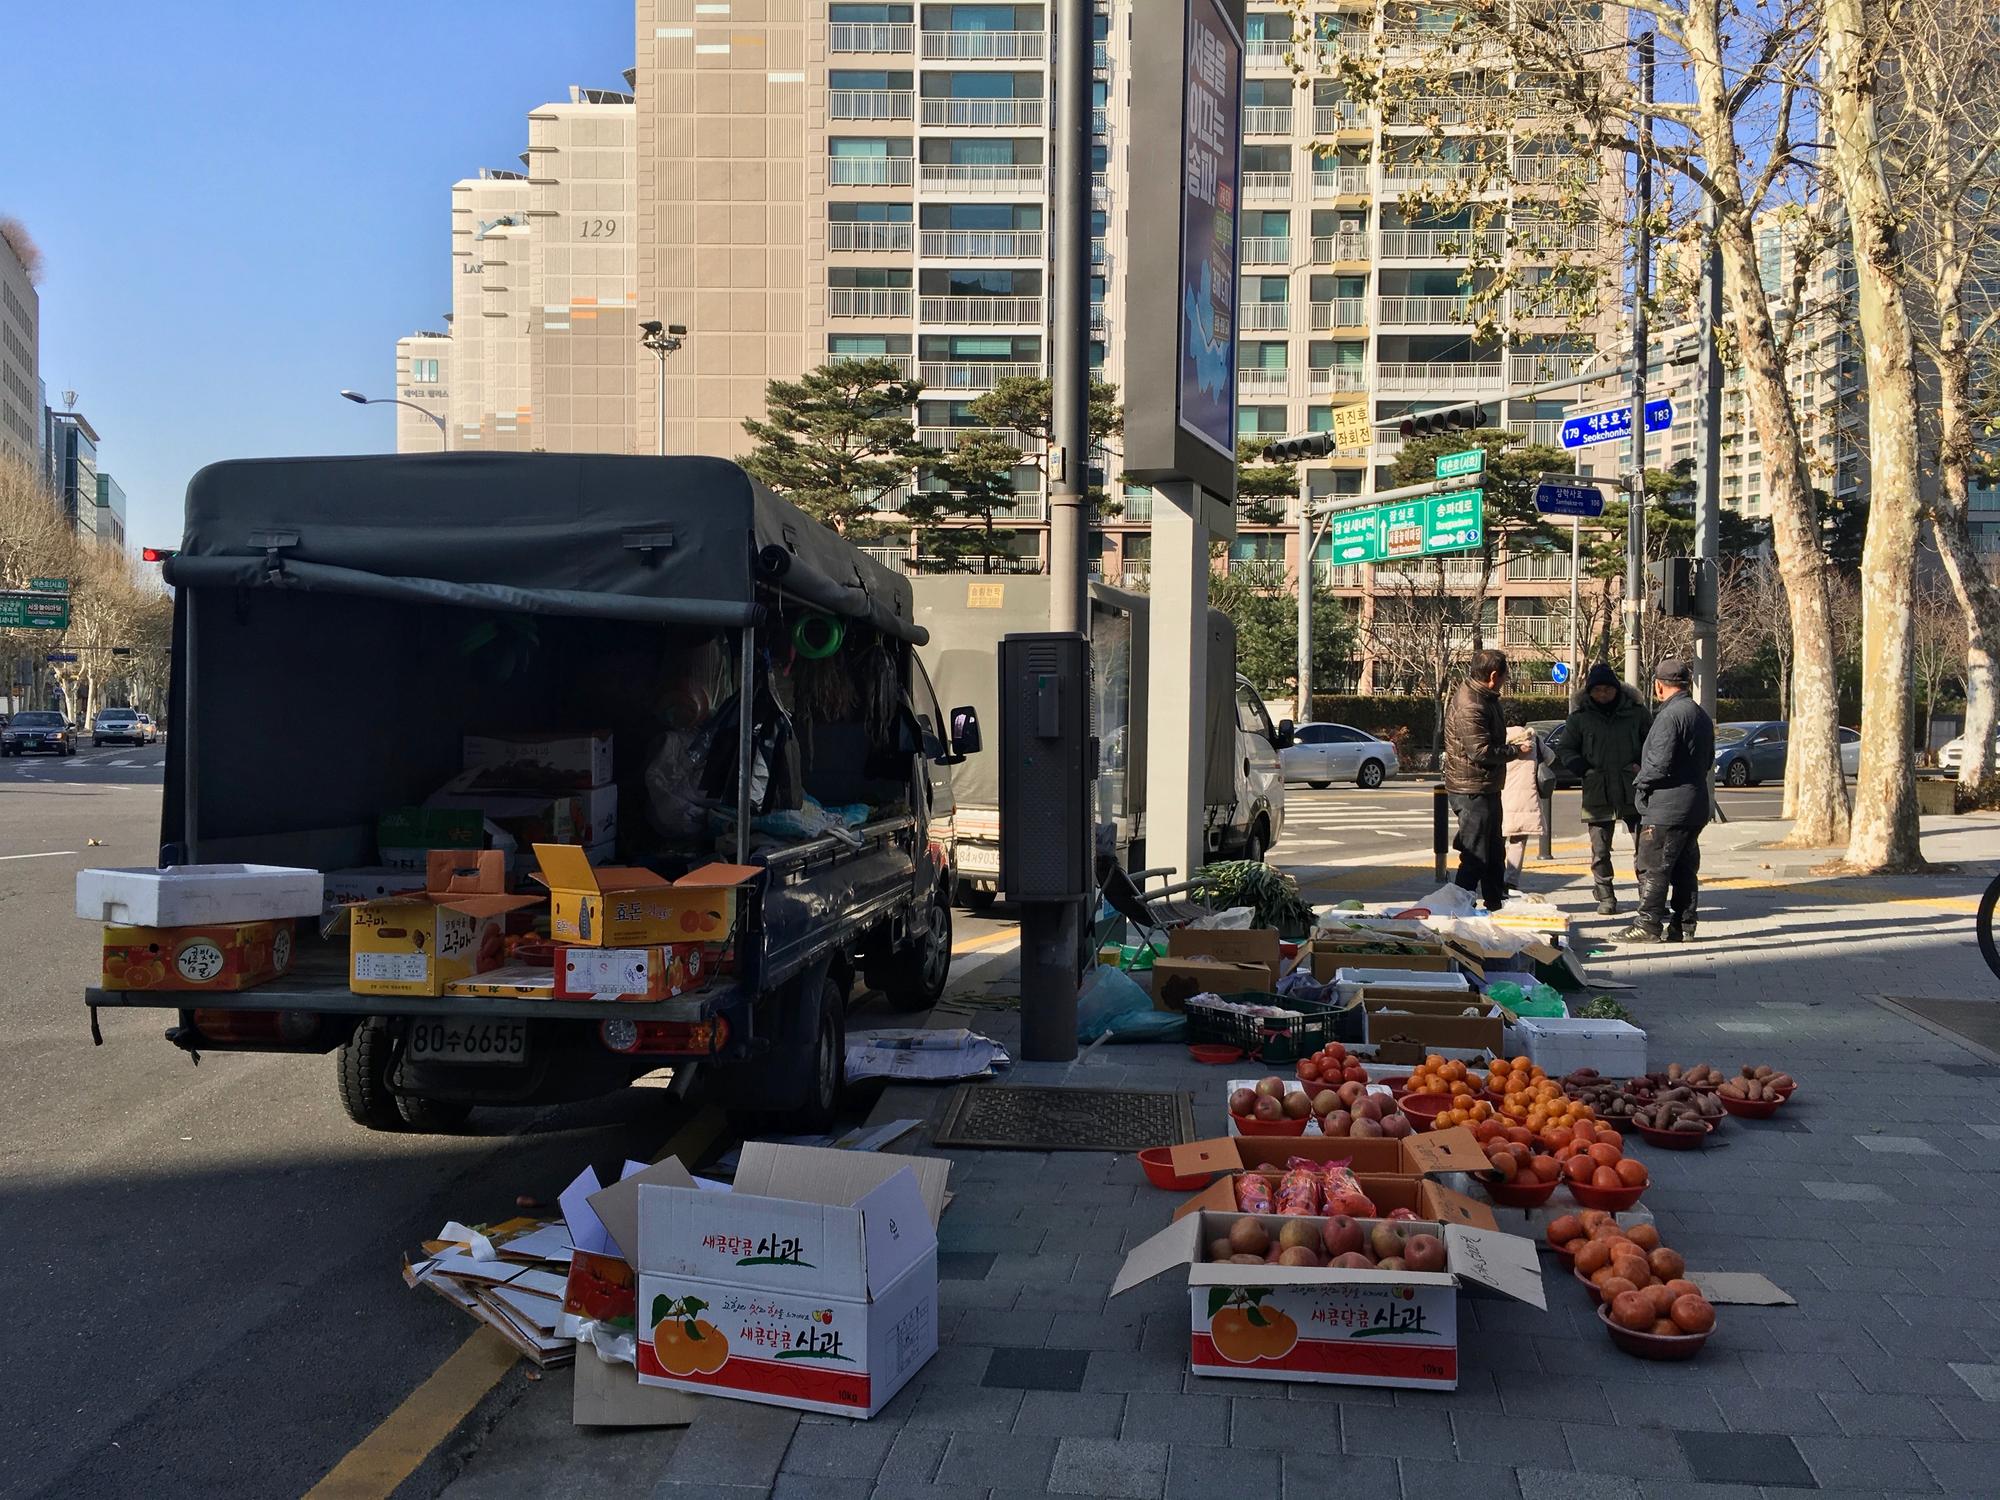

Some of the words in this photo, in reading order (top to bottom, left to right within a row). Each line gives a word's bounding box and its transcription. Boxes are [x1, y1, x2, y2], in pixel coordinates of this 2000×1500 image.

[1190, 18, 1227, 98] 서울을
[1189, 81, 1225, 156] 이끄는
[1188, 141, 1218, 208] 송파!
[580, 219, 617, 238] 129
[1335, 407, 1368, 427] 직진후
[1653, 408, 1670, 423] 183
[1337, 427, 1371, 447] 좌회전
[1565, 427, 1580, 440] 179
[1437, 499, 1473, 518] 송파대로
[354, 913, 388, 928] 고구마
[442, 930, 476, 955] 고구마
[413, 1023, 524, 1054] 80수6655
[702, 1234, 753, 1257] 새콤달콤
[756, 1232, 804, 1264] 사과
[1311, 1306, 1370, 1328] 새콤달콤
[1373, 1302, 1427, 1332] 사과
[740, 1326, 793, 1350] 새콤달콤
[795, 1325, 844, 1356] 사과
